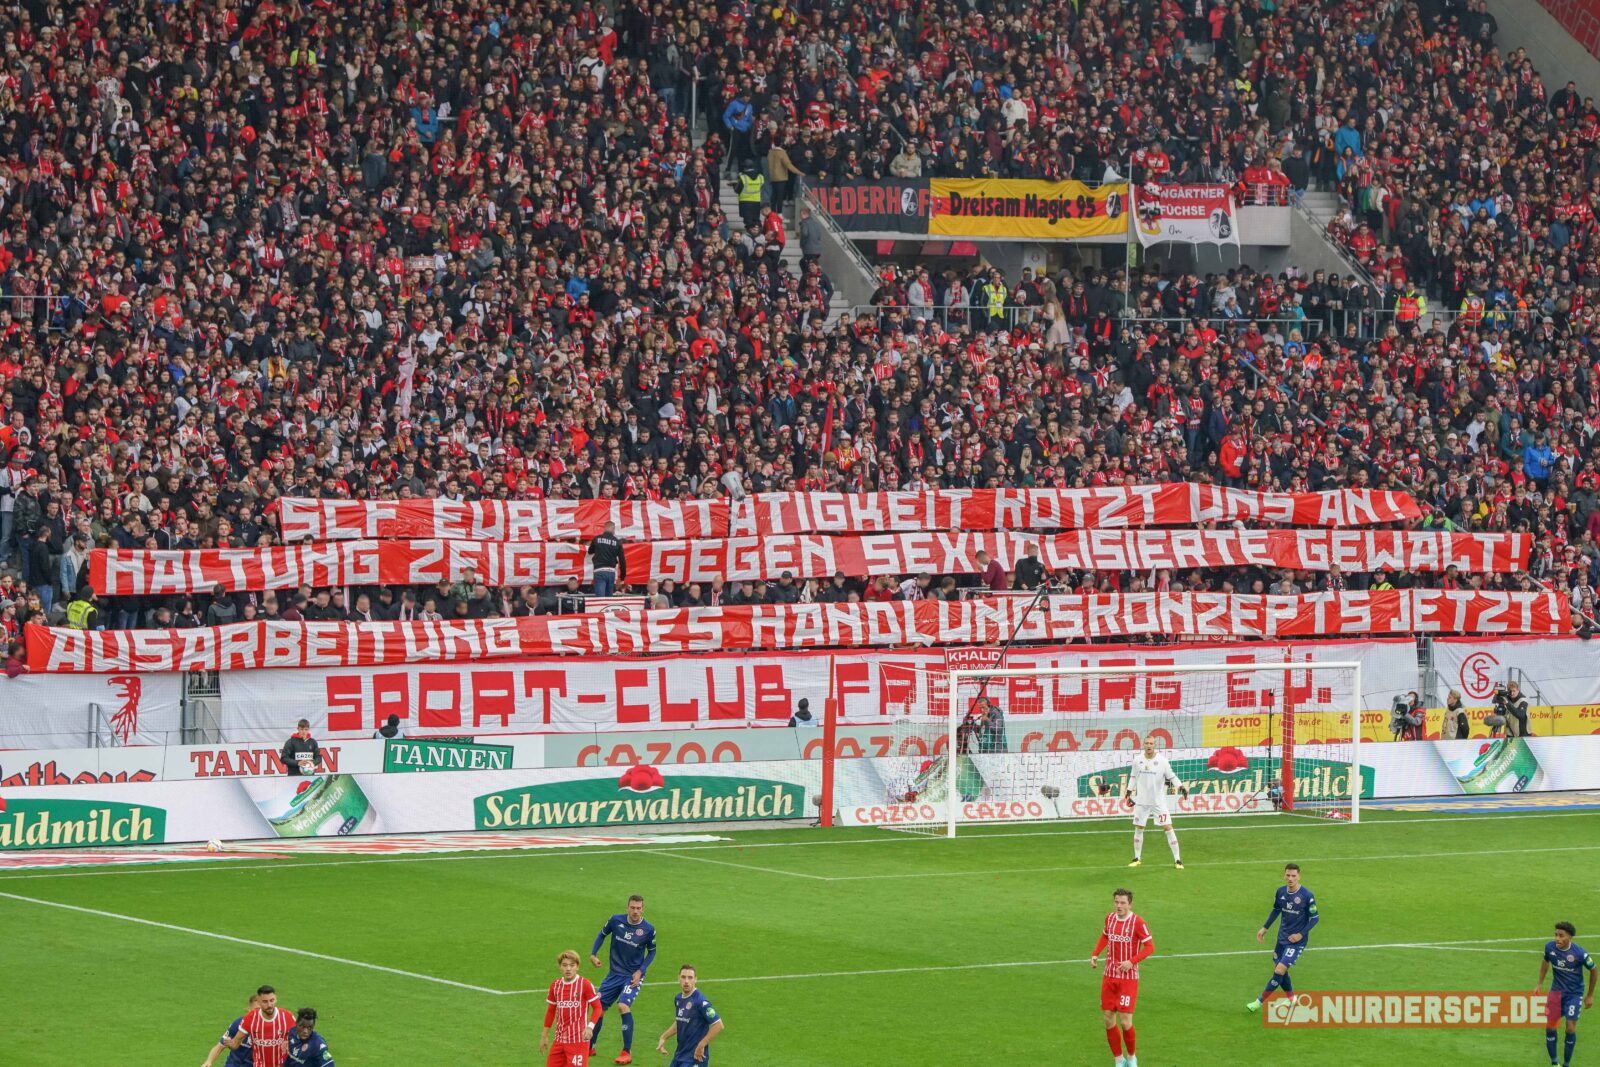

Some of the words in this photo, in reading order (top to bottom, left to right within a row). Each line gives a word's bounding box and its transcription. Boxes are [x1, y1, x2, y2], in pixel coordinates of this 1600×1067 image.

[950, 192, 1020, 216] Dreisam
[1024, 193, 1071, 225] Magic
[1077, 195, 1095, 218] 95
[1160, 204, 1205, 216] FÜCHSE
[282, 498, 400, 540] SCF
[433, 499, 581, 542] EURE
[994, 485, 1162, 528] KOTZT
[1190, 484, 1295, 524] UNS
[106, 540, 378, 593] HALTUNG
[651, 535, 836, 581] GEGEN
[860, 530, 1277, 576] SEXUALISIERTE
[1297, 530, 1521, 573] GEWALT!
[47, 618, 521, 671] AUSARBEITUNG
[547, 606, 723, 655] EINES
[1391, 589, 1562, 632] JETZT!
[949, 651, 1001, 662] KHALID
[326, 665, 791, 731] SPORT-CLUB
[1230, 717, 1261, 728] LOTTO
[191, 747, 341, 777] TANNN
[390, 743, 508, 769] TANNEN
[292, 785, 345, 832] Weidemilch
[484, 782, 794, 828] Schwarzwaldmilch
[963, 800, 1042, 819] CAZOO
[1178, 794, 1258, 811] CAZOO
[855, 804, 935, 823] CAZOO
[1285, 948, 1295, 957] 19
[1120, 995, 1131, 1007] 38
[1568, 1005, 1575, 1016] 8
[572, 1055, 583, 1066] 42
